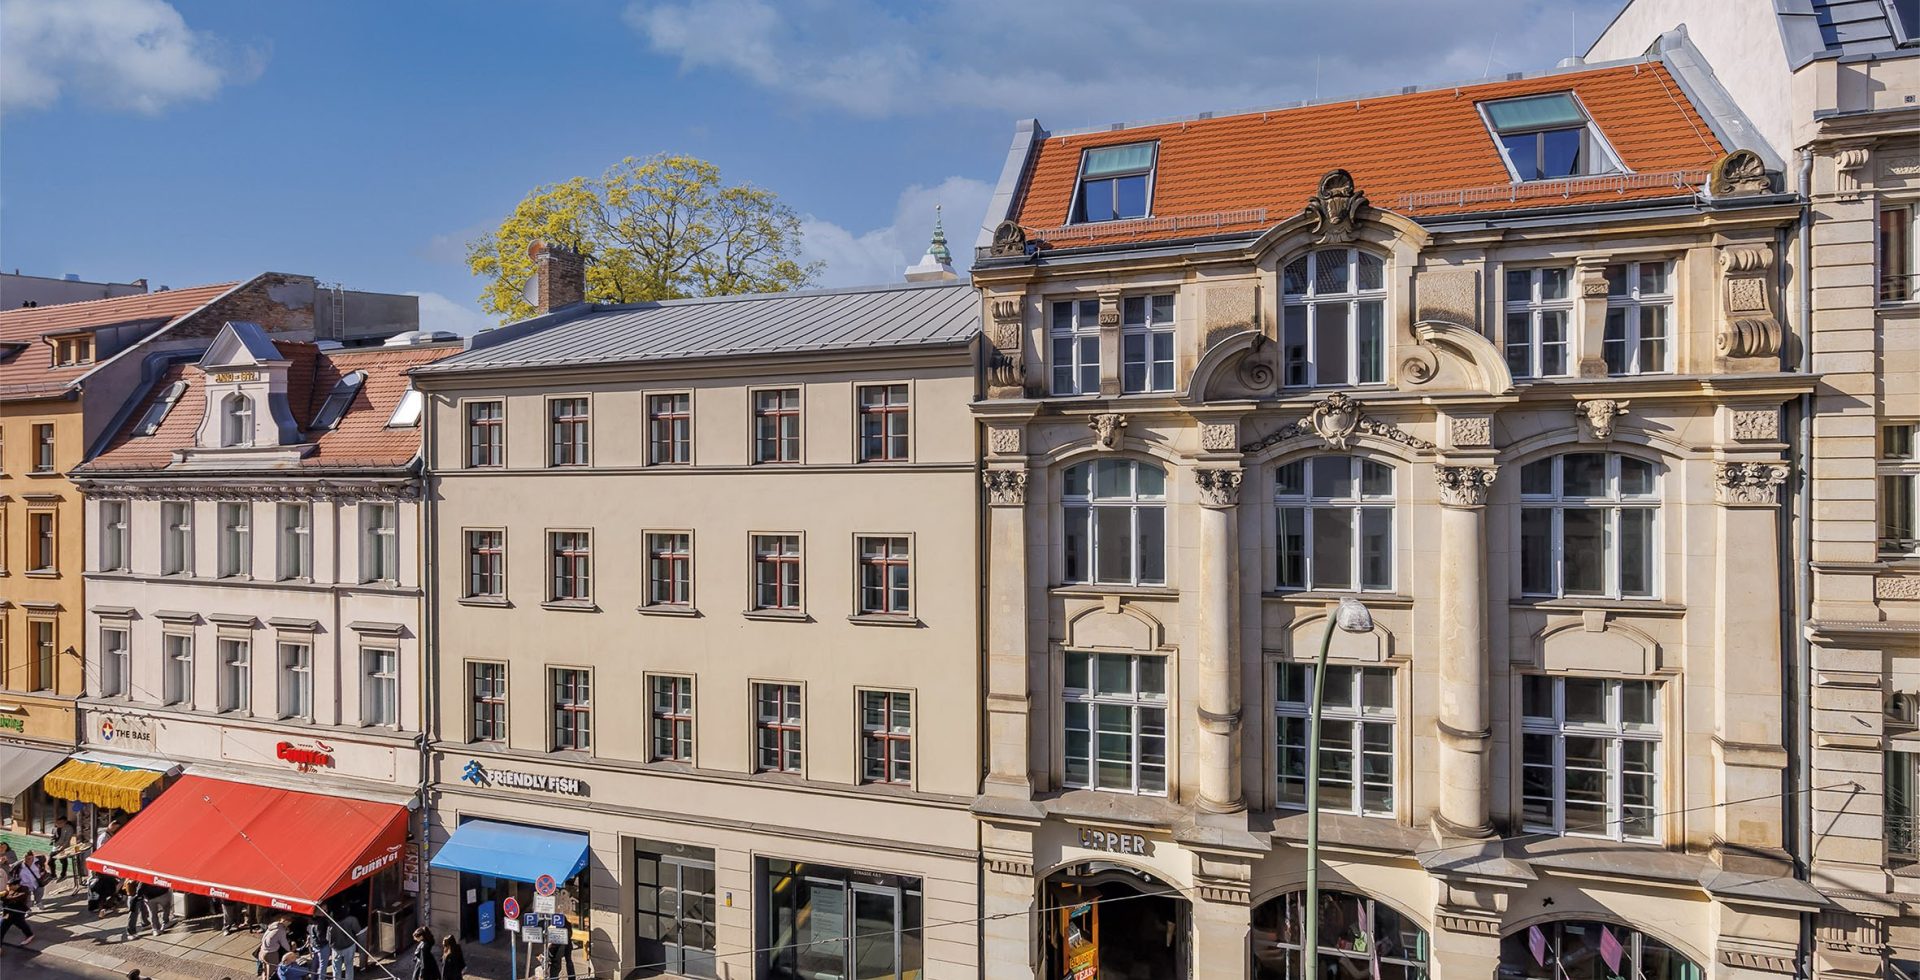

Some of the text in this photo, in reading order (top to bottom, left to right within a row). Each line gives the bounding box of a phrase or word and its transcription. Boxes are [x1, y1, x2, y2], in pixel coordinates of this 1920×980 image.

[116, 729, 151, 740] THE BASE
[1078, 828, 1145, 854] UPPER
[526, 915, 534, 925] P
[553, 915, 560, 923] P
